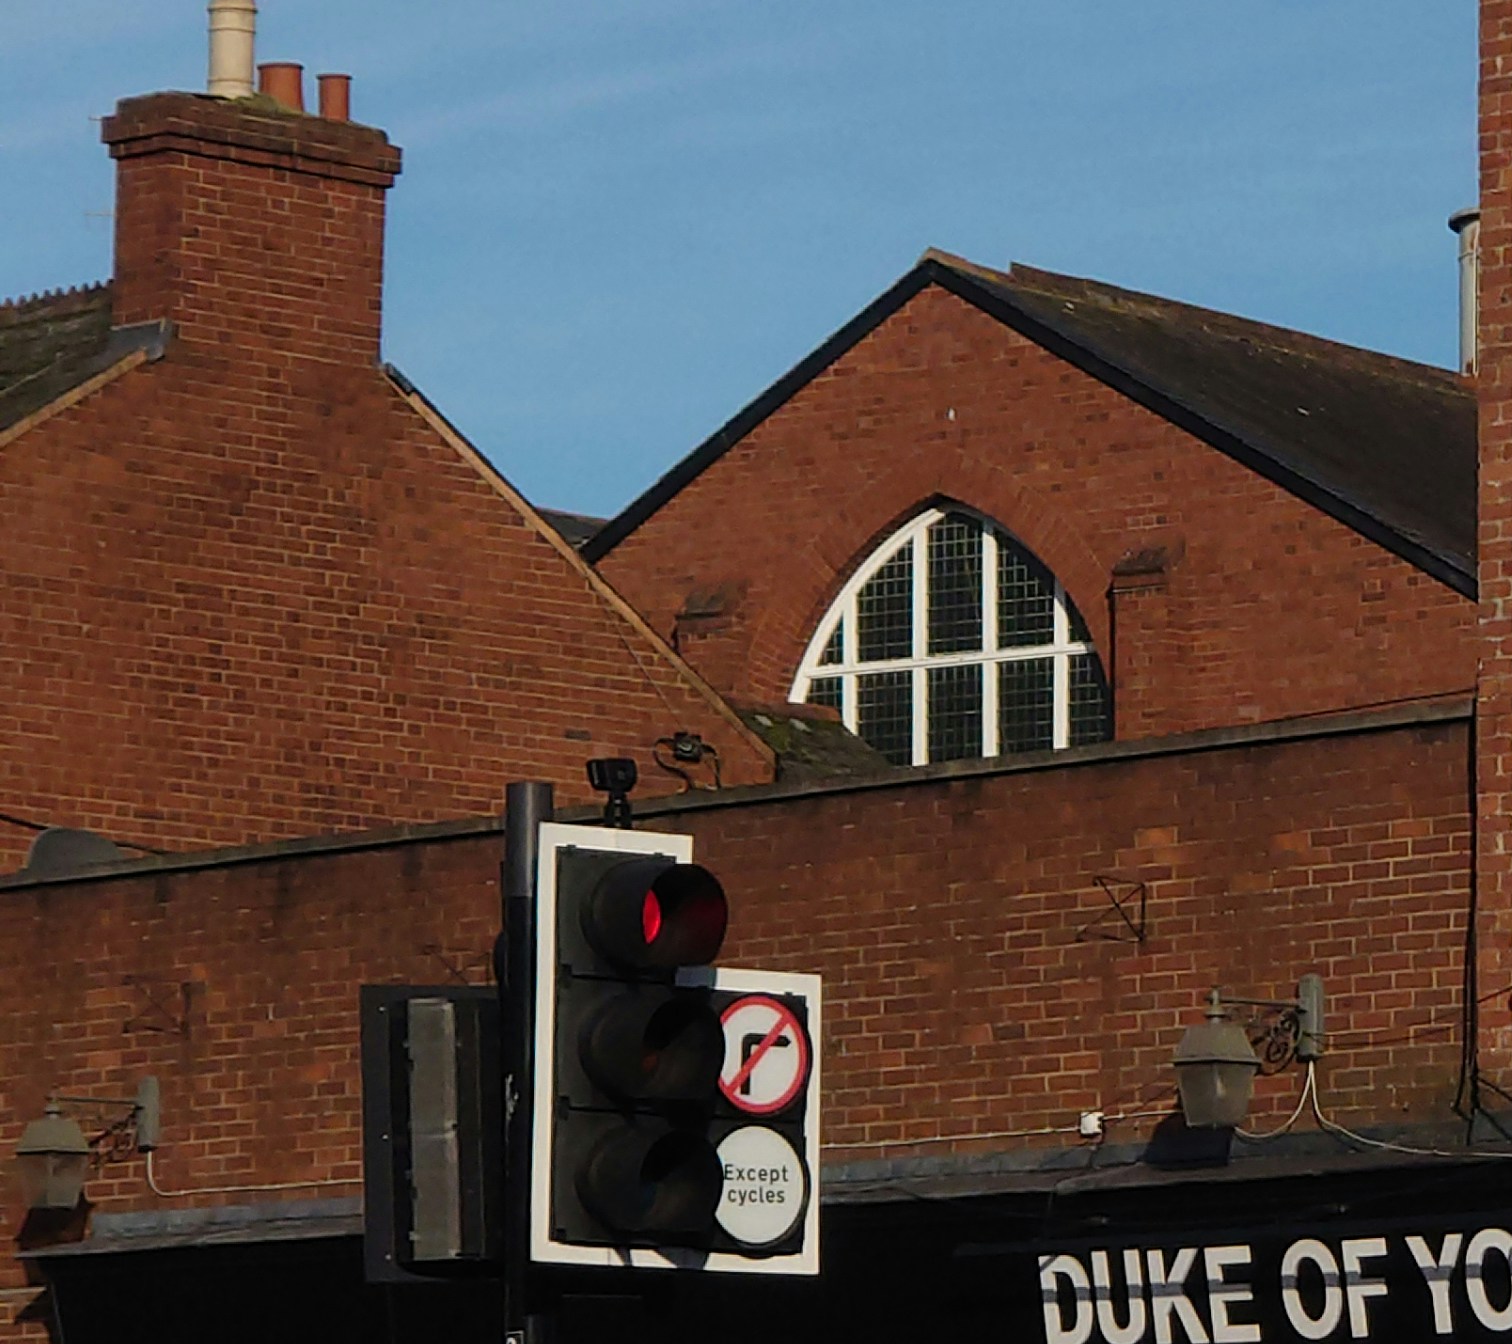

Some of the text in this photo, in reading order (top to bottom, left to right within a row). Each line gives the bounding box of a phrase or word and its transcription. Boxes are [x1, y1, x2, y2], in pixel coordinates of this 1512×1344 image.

[724, 1164, 789, 1184] Except
[727, 1187, 786, 1205] cycles
[1281, 1236, 1388, 1340] OF
